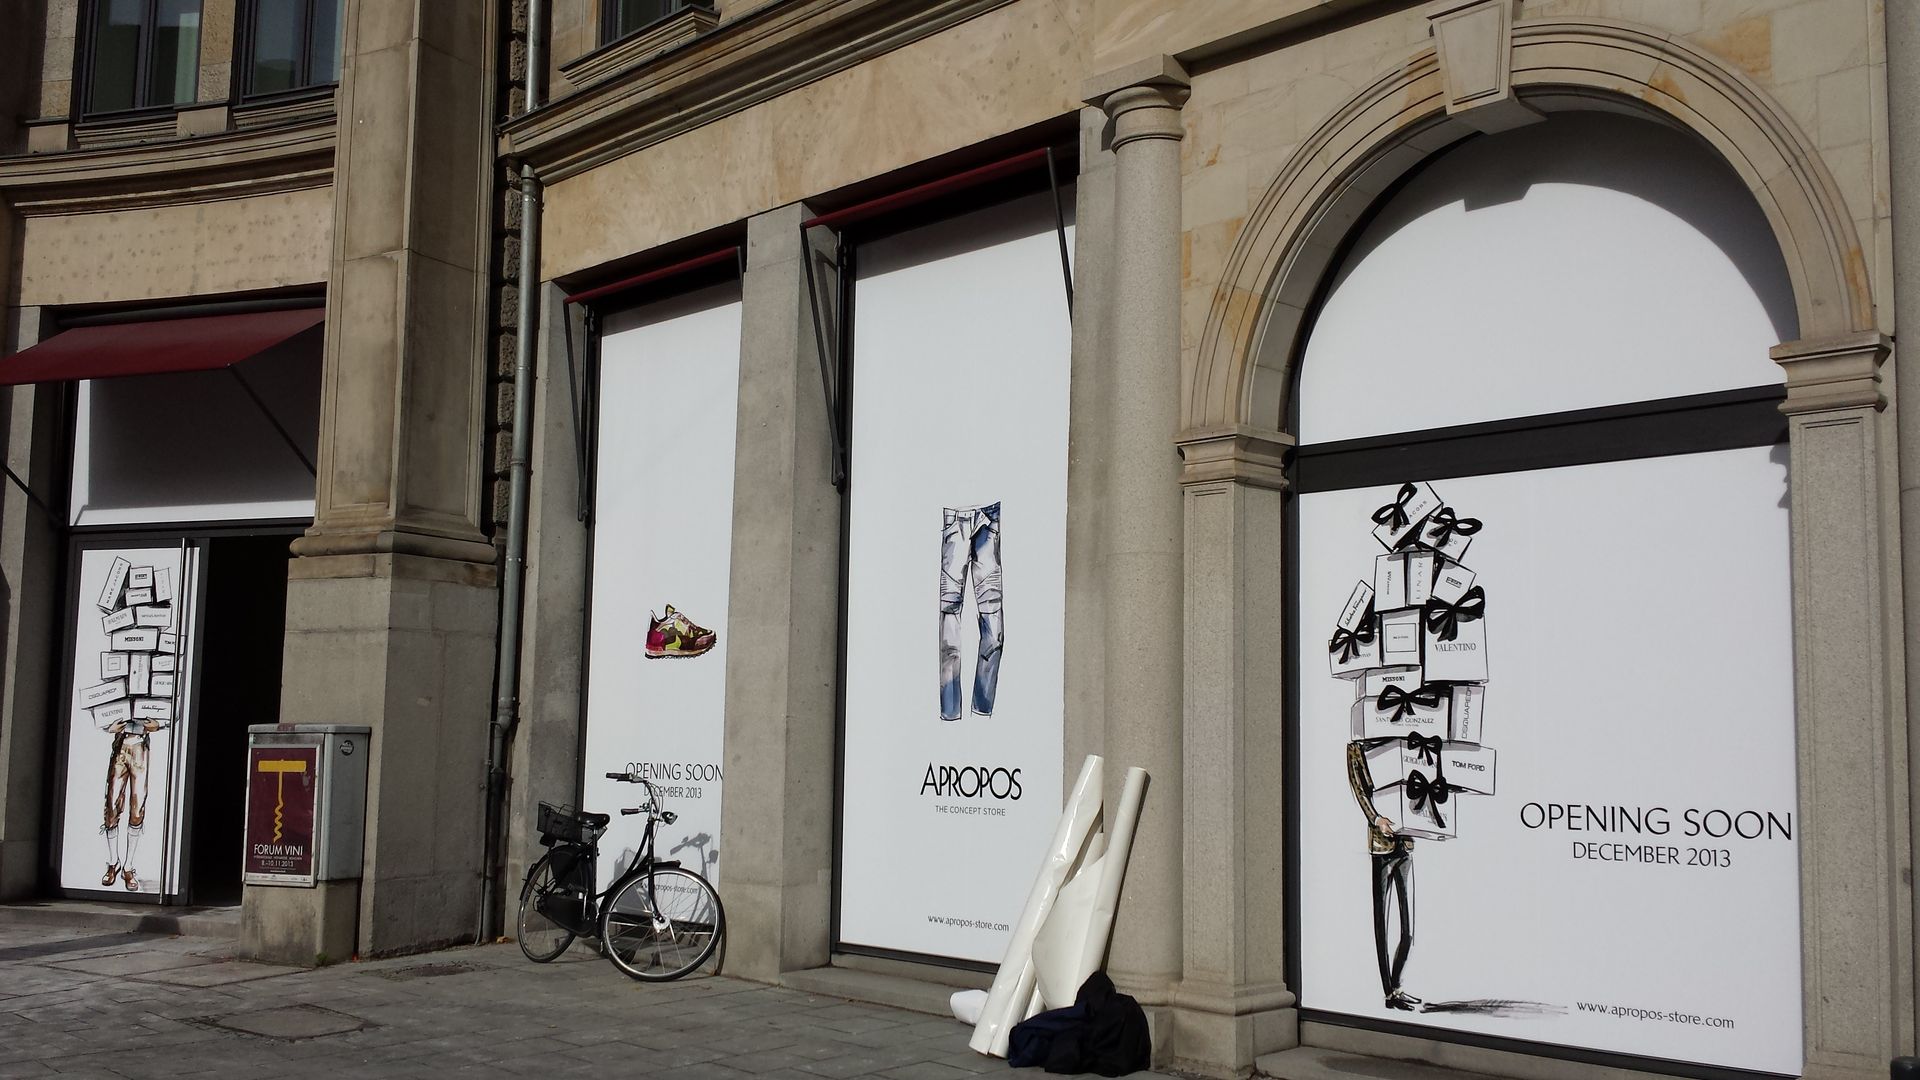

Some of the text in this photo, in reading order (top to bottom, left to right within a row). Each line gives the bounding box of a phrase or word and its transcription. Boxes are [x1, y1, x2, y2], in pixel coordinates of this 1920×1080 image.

[1434, 642, 1477, 652] VALENTINO
[625, 762, 681, 781] OPENING
[1451, 760, 1486, 772] TOM FORD
[920, 761, 1023, 800] APROPOS
[685, 787, 702, 799] 2013
[936, 805, 1006, 816] THE CONCEPT STORE
[1520, 802, 1792, 840] OPENING SOON
[253, 844, 303, 856] FORUM VINI
[1573, 841, 1732, 868] DECEMBER 2013
[927, 915, 1010, 932] www.apropos-store.com
[1576, 1001, 1735, 1029] www.apropos-store.com
